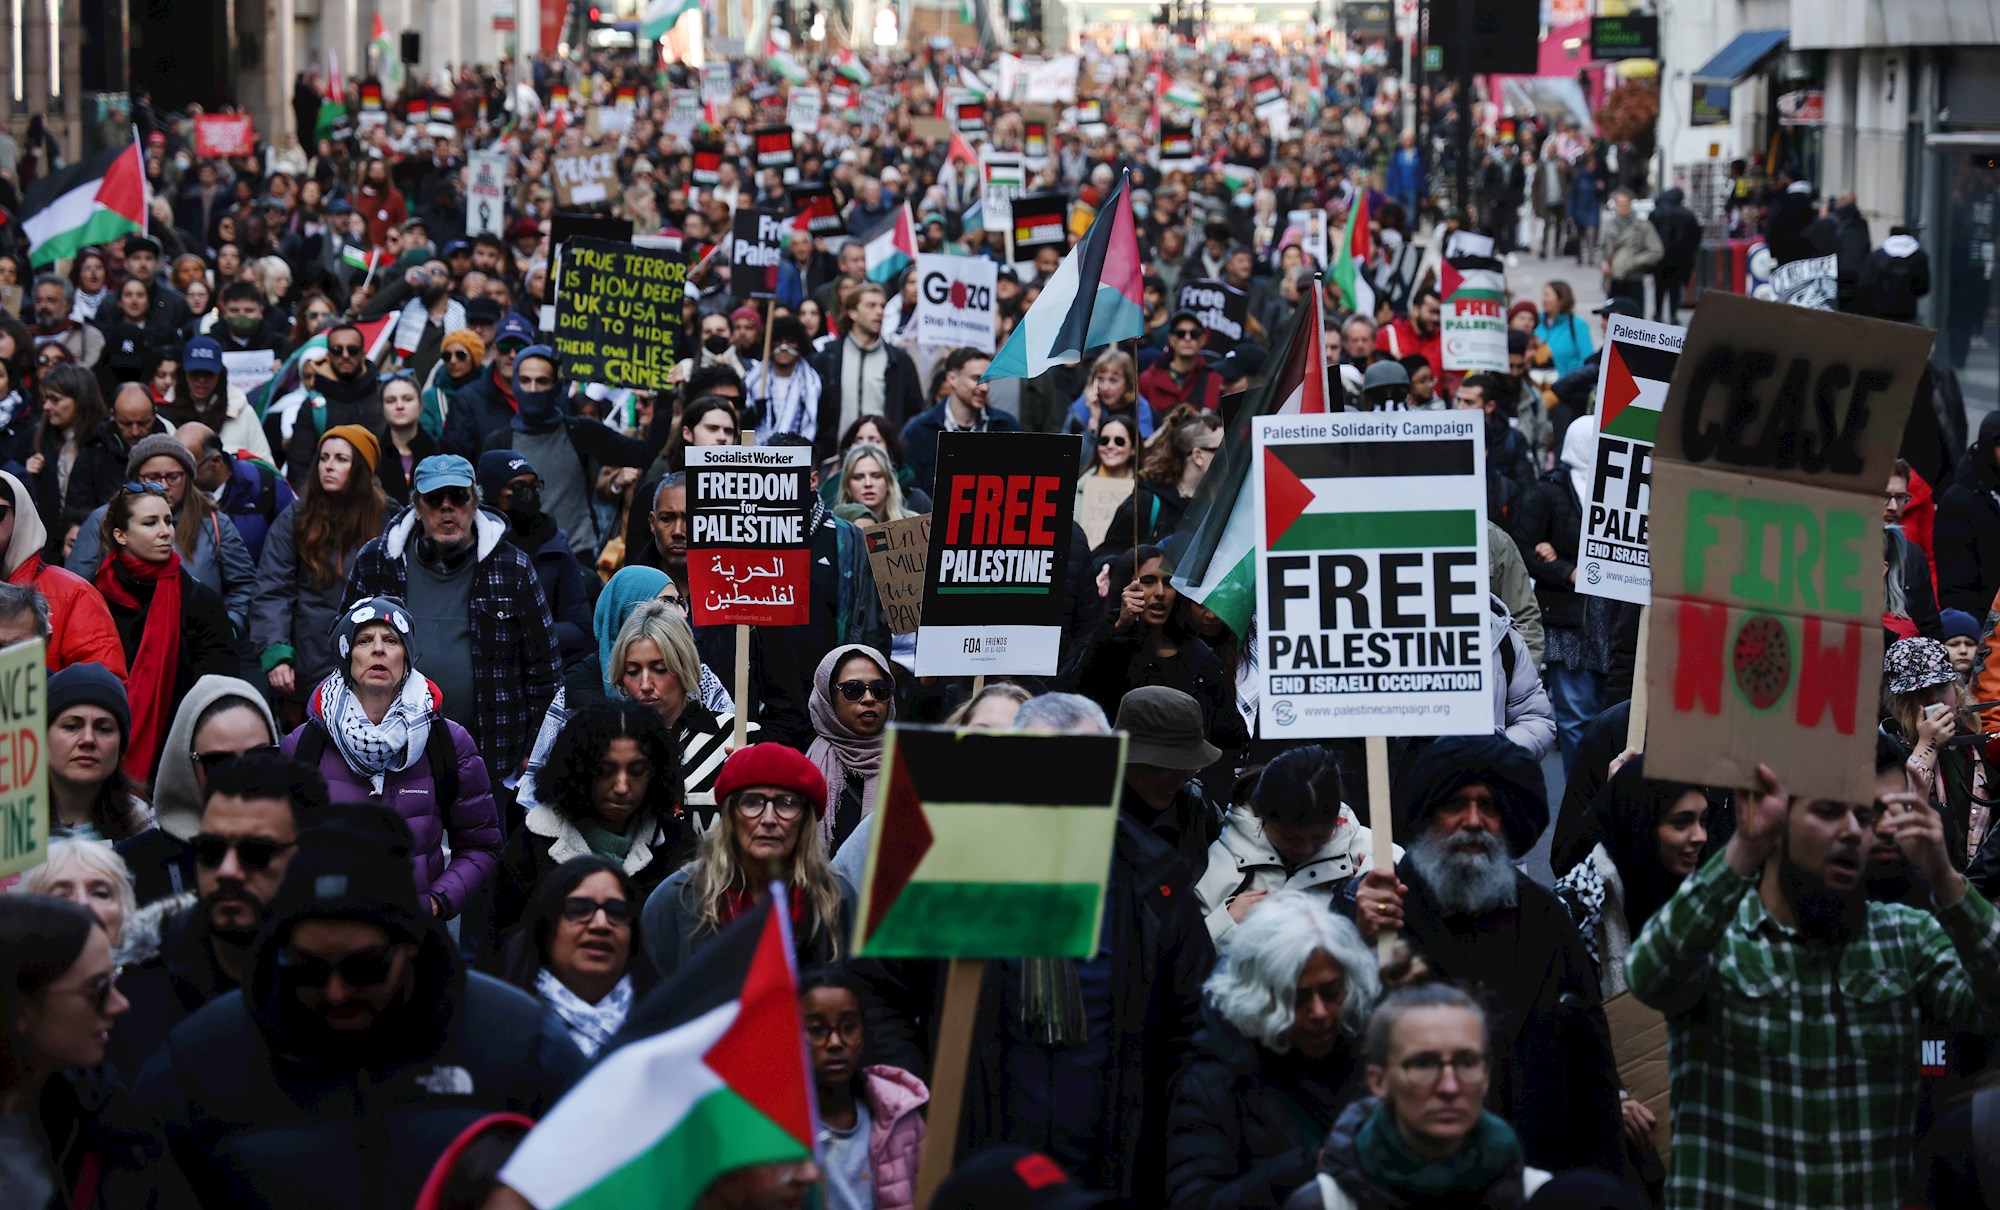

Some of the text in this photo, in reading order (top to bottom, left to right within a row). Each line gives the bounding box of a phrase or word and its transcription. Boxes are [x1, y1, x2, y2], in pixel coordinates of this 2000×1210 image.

[555, 152, 612, 188] PEACE
[572, 248, 687, 284] TRUE TERROR
[734, 239, 780, 266] Pales
[565, 270, 684, 303] IS HOW DEEP
[1181, 285, 1225, 309] Free
[574, 292, 600, 315] UK
[619, 301, 656, 325] USA
[1196, 308, 1242, 340] stine
[560, 313, 673, 345] DIG TO HIDE
[1613, 324, 1656, 343] Palestine
[555, 337, 675, 371] THEIR OWN LIES
[571, 359, 675, 390] AND CRIMES
[1682, 343, 1894, 475] CEASE
[1263, 421, 1473, 440] Palestine Solidarity Campaign
[697, 472, 798, 501] FREEDOM
[1592, 436, 1651, 509] FR
[740, 500, 757, 514] for
[945, 474, 1061, 546] FREE
[693, 514, 803, 544] PALESTINE
[1588, 505, 1649, 545] PALE
[939, 549, 1054, 583] PALESTINE
[1587, 541, 1650, 566] END ISRAEL
[1682, 488, 1867, 614] FIRE
[711, 554, 784, 583] الحرية
[1606, 571, 1652, 587] www.palestin
[705, 583, 795, 610] لفلسطين
[1266, 552, 1480, 631] FREE
[963, 637, 1007, 653] FOA FRIENDS
[1268, 631, 1481, 670] PALESTINE
[1271, 673, 1480, 694] END ISRAELI OCCUPATION
[1674, 600, 1861, 736] NOW
[0, 662, 37, 723] NCE
[1304, 704, 1450, 717] www.palestinecampaign.org
[0, 728, 38, 793] EID
[0, 795, 36, 861] INE
[1921, 1040, 1946, 1065] NE
